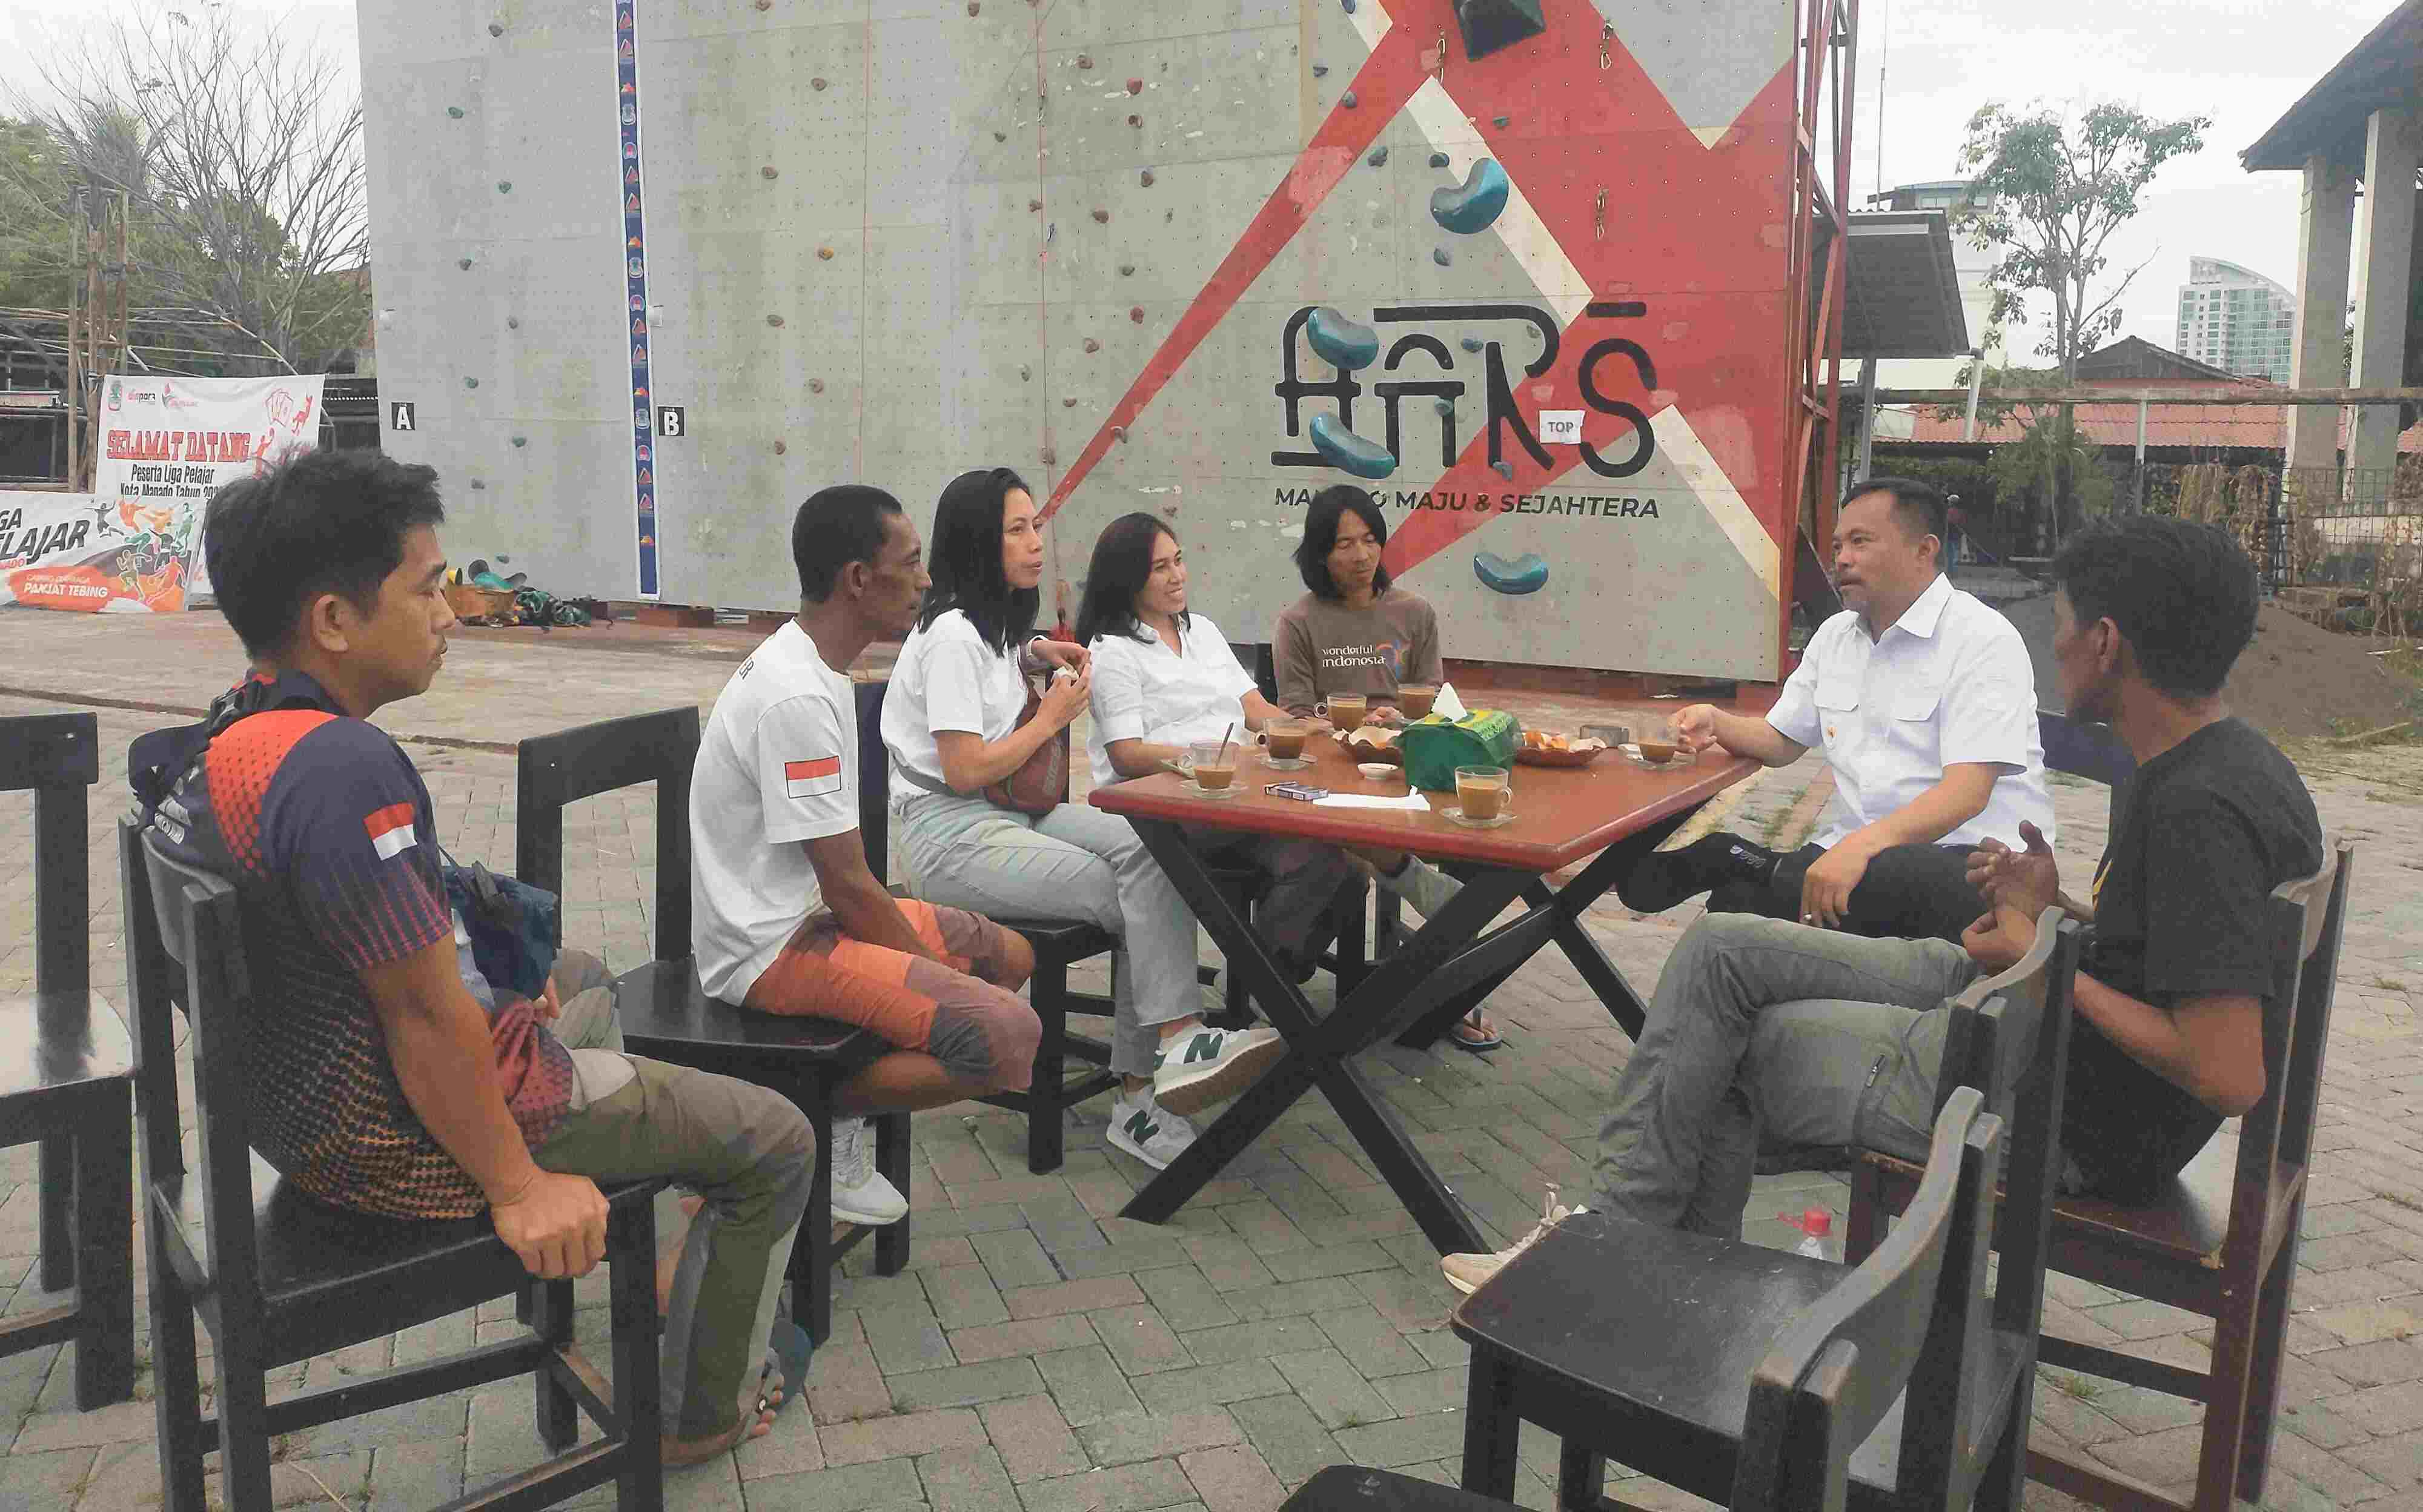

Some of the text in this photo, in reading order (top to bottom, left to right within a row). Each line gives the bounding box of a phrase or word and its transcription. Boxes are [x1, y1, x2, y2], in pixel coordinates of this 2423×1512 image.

[397, 406, 412, 429] A
[664, 411, 679, 436] B
[1547, 422, 1574, 433] TOP
[107, 430, 250, 463] SELAMAT DATANG
[131, 464, 214, 485] Peserta Liga Pelajar
[121, 483, 139, 496] Kota
[1274, 488, 1659, 519] MAO MAJU & SEJAHTERA
[24, 582, 107, 598] PANJAT TEBING
[1321, 643, 1373, 655] wonderful
[1183, 1032, 1224, 1064] N
[1124, 1109, 1161, 1146] N
